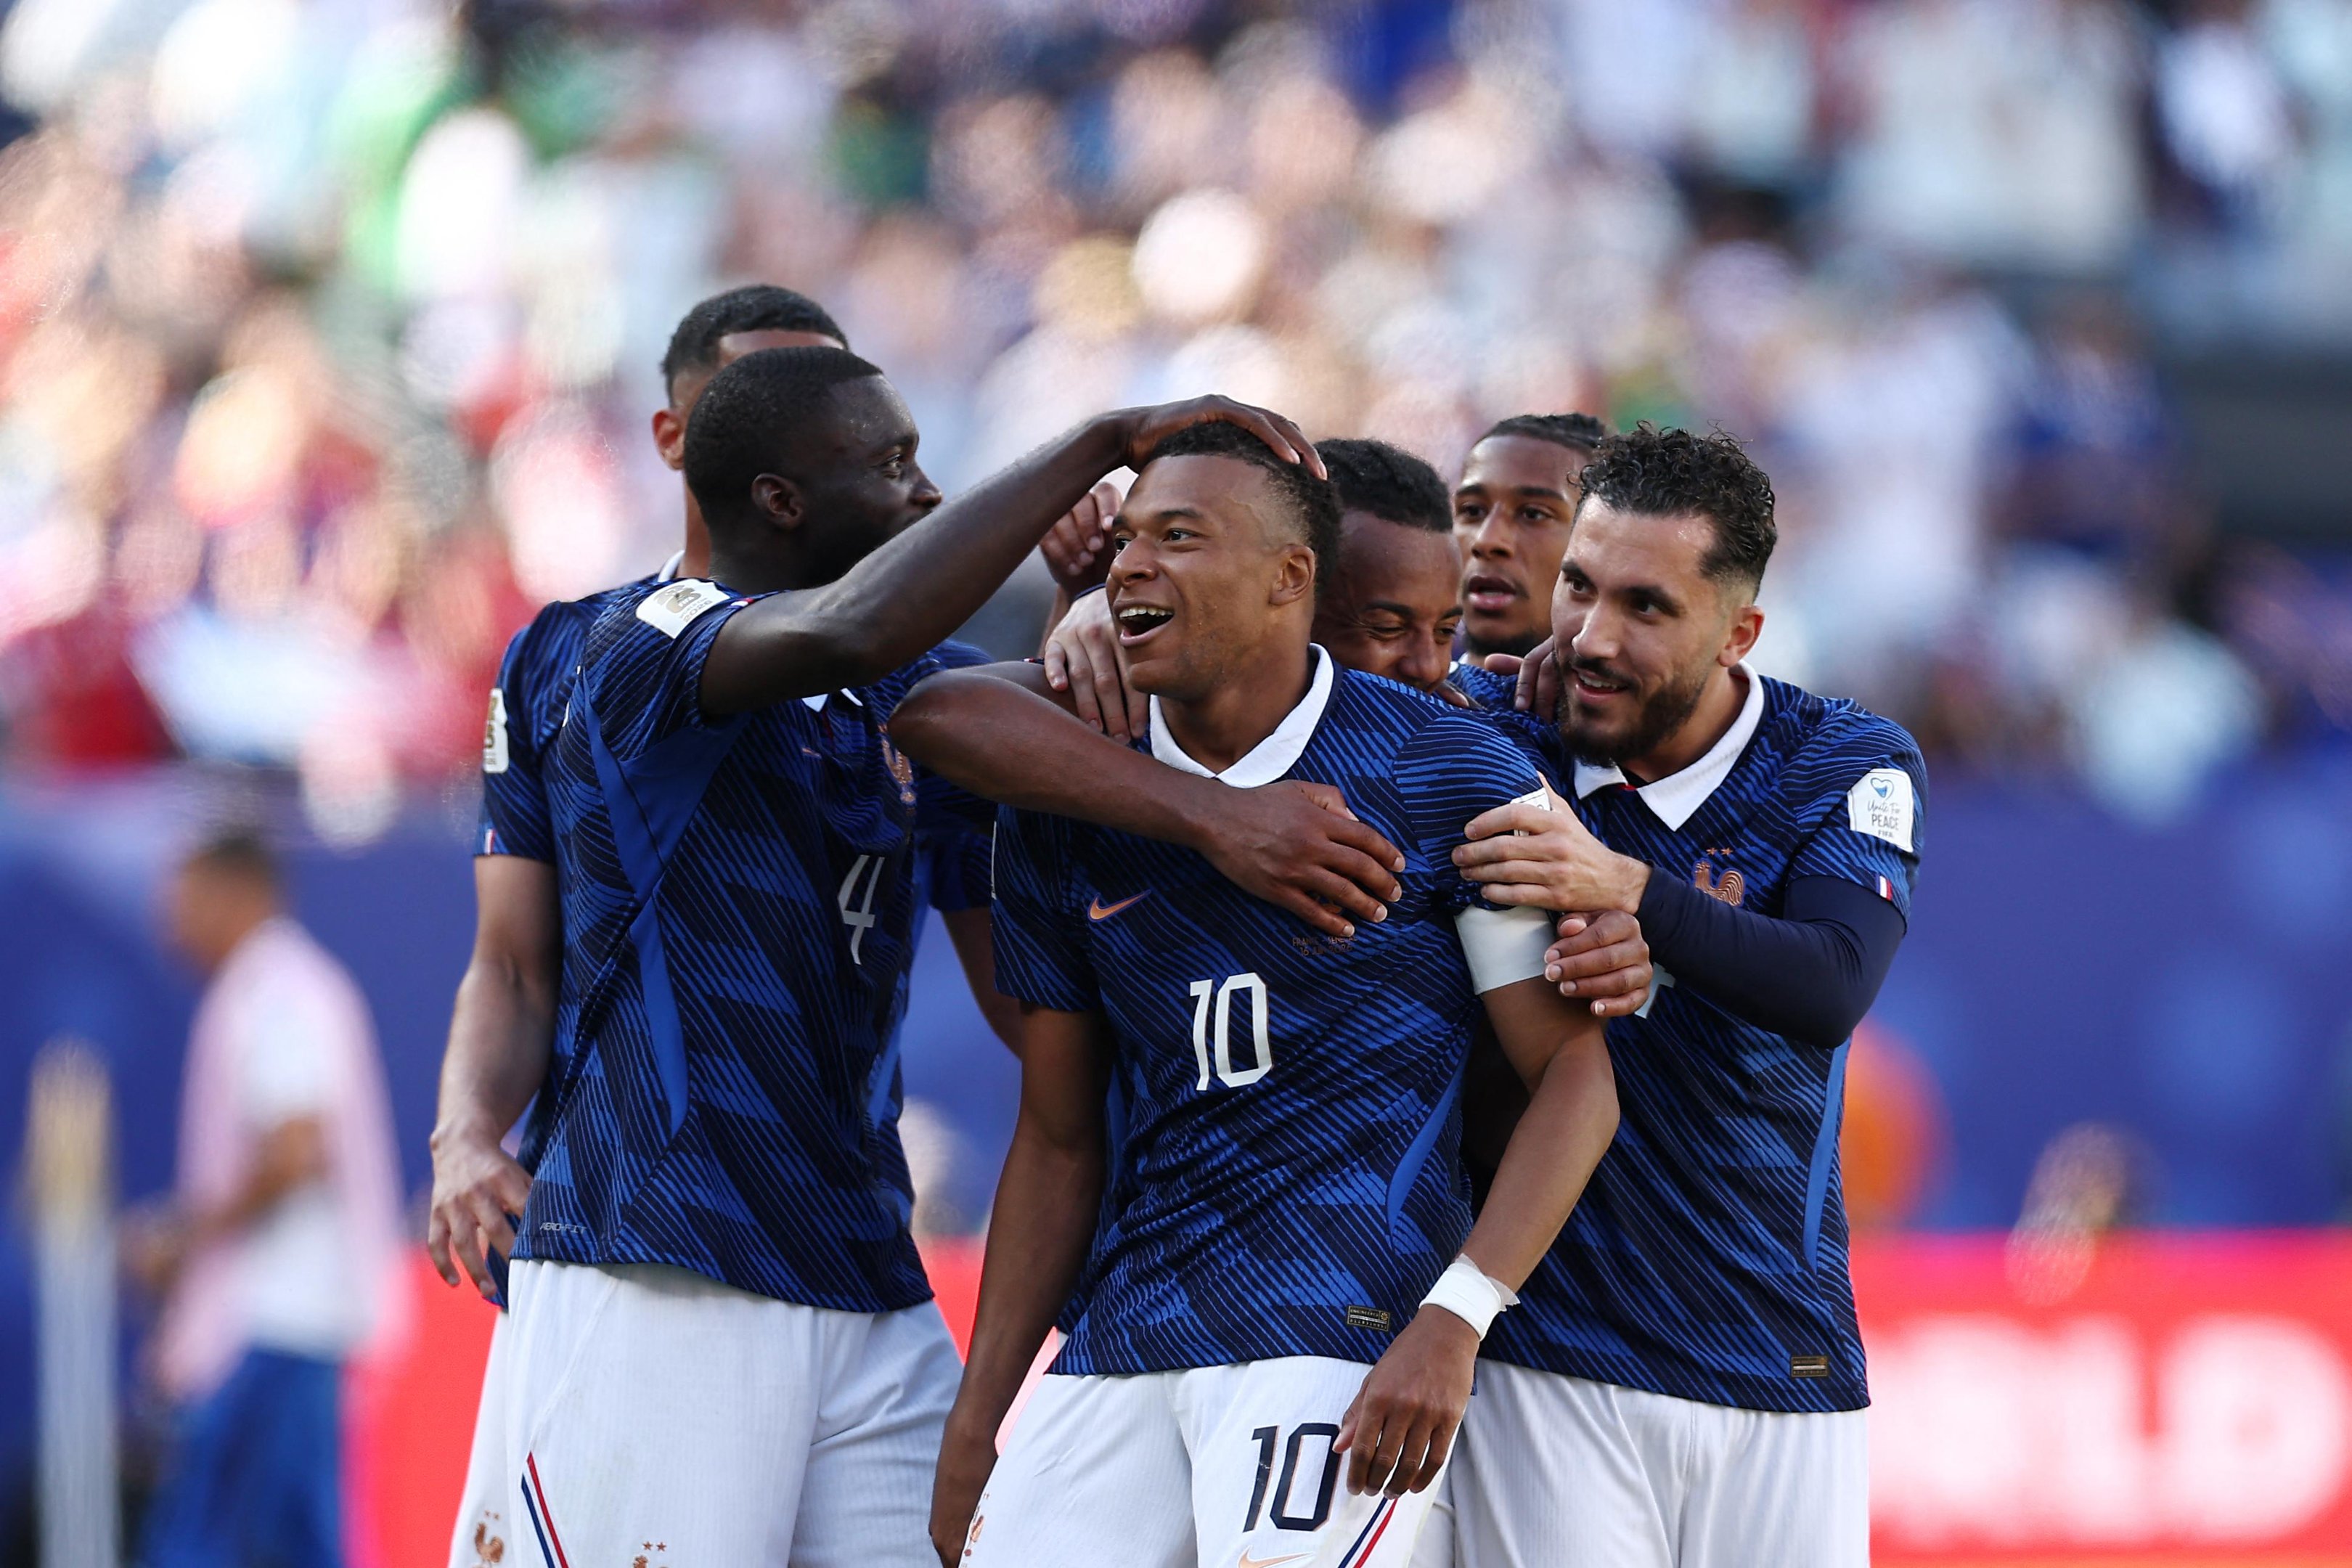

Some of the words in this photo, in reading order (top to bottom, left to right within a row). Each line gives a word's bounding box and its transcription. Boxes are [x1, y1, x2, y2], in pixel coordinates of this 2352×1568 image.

[683, 600, 713, 623] 2026
[1871, 814, 1899, 831] PEACE
[1878, 829, 1894, 838] FIFA
[838, 854, 875, 965] 4
[1190, 972, 1272, 1090] 10
[1243, 1423, 1343, 1532] 10
